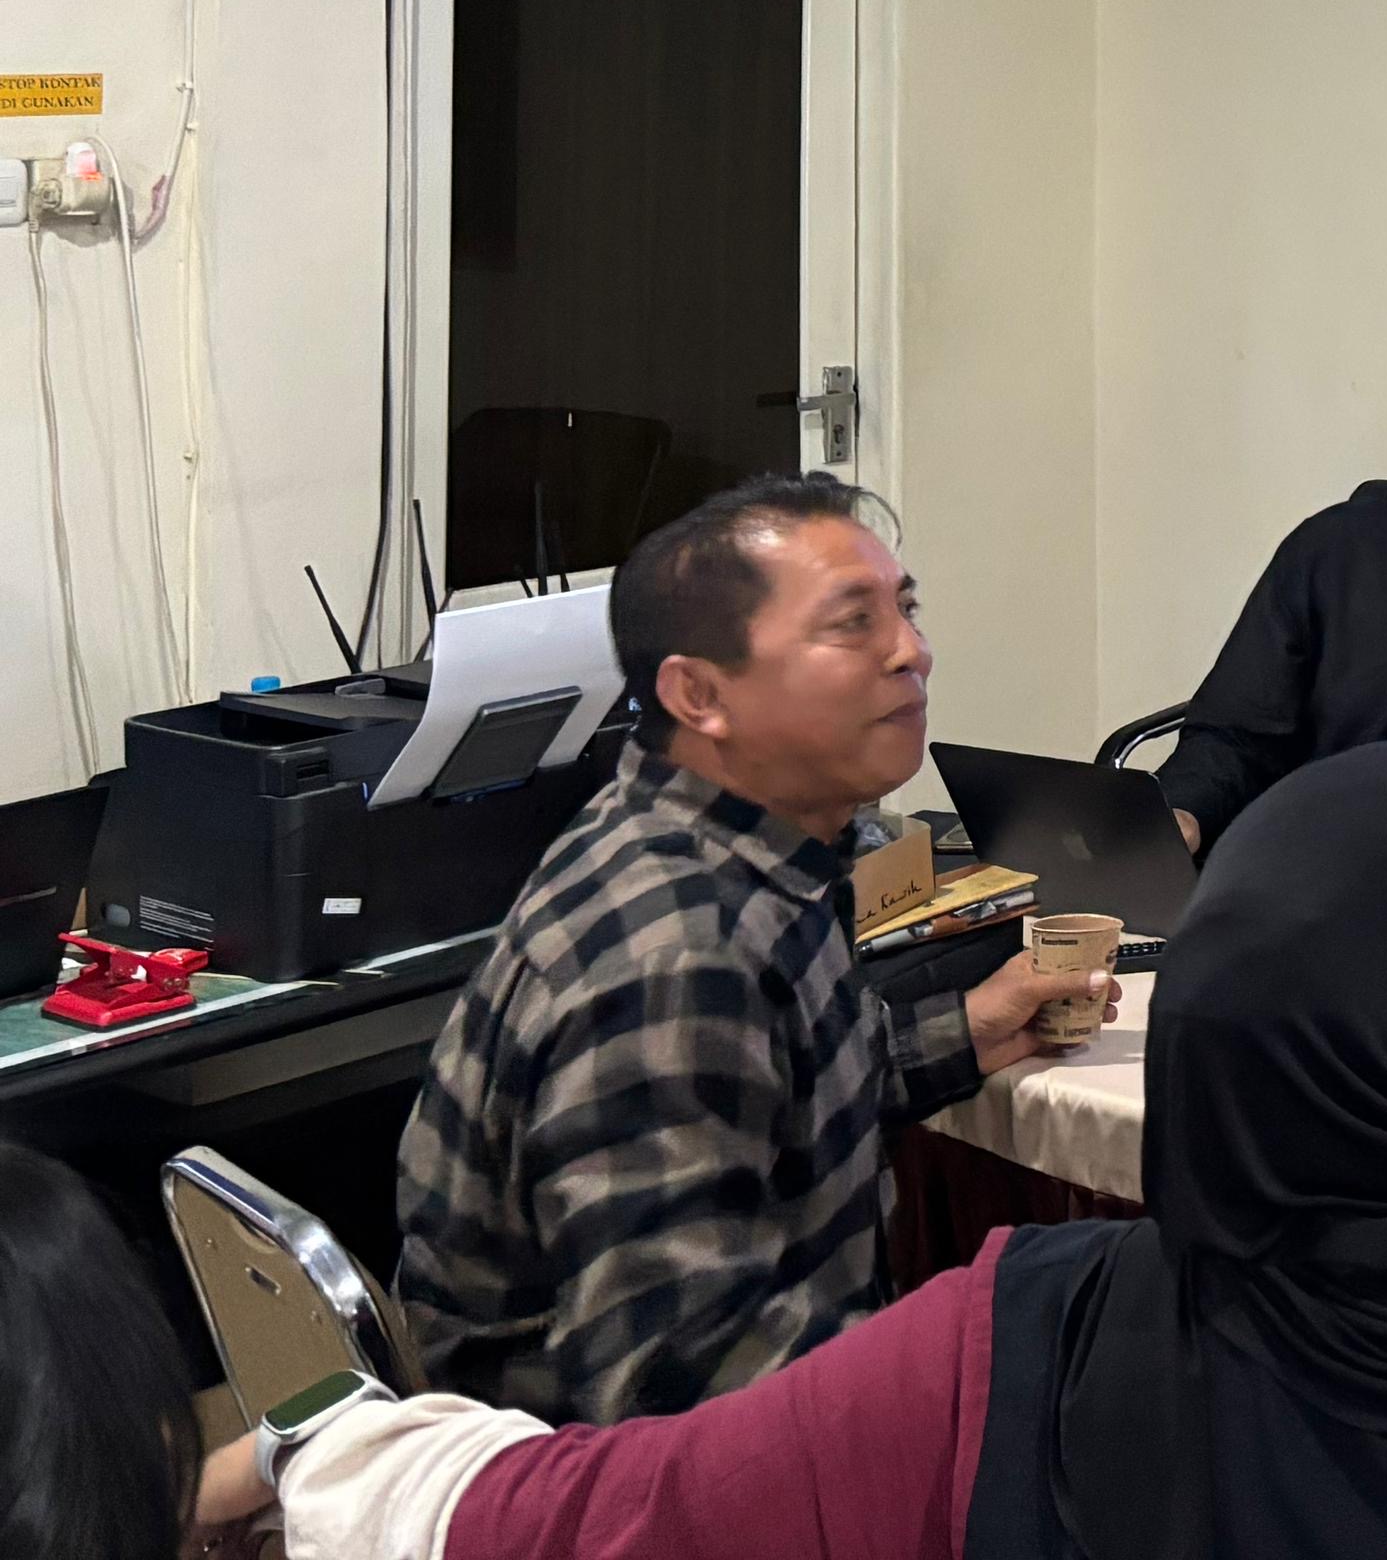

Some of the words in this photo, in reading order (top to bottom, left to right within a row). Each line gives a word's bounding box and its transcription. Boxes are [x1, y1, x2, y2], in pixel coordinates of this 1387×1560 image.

[40, 77, 100, 90] KONTAK
[2, 97, 16, 109] DI
[22, 95, 94, 109] GUNAKAN
